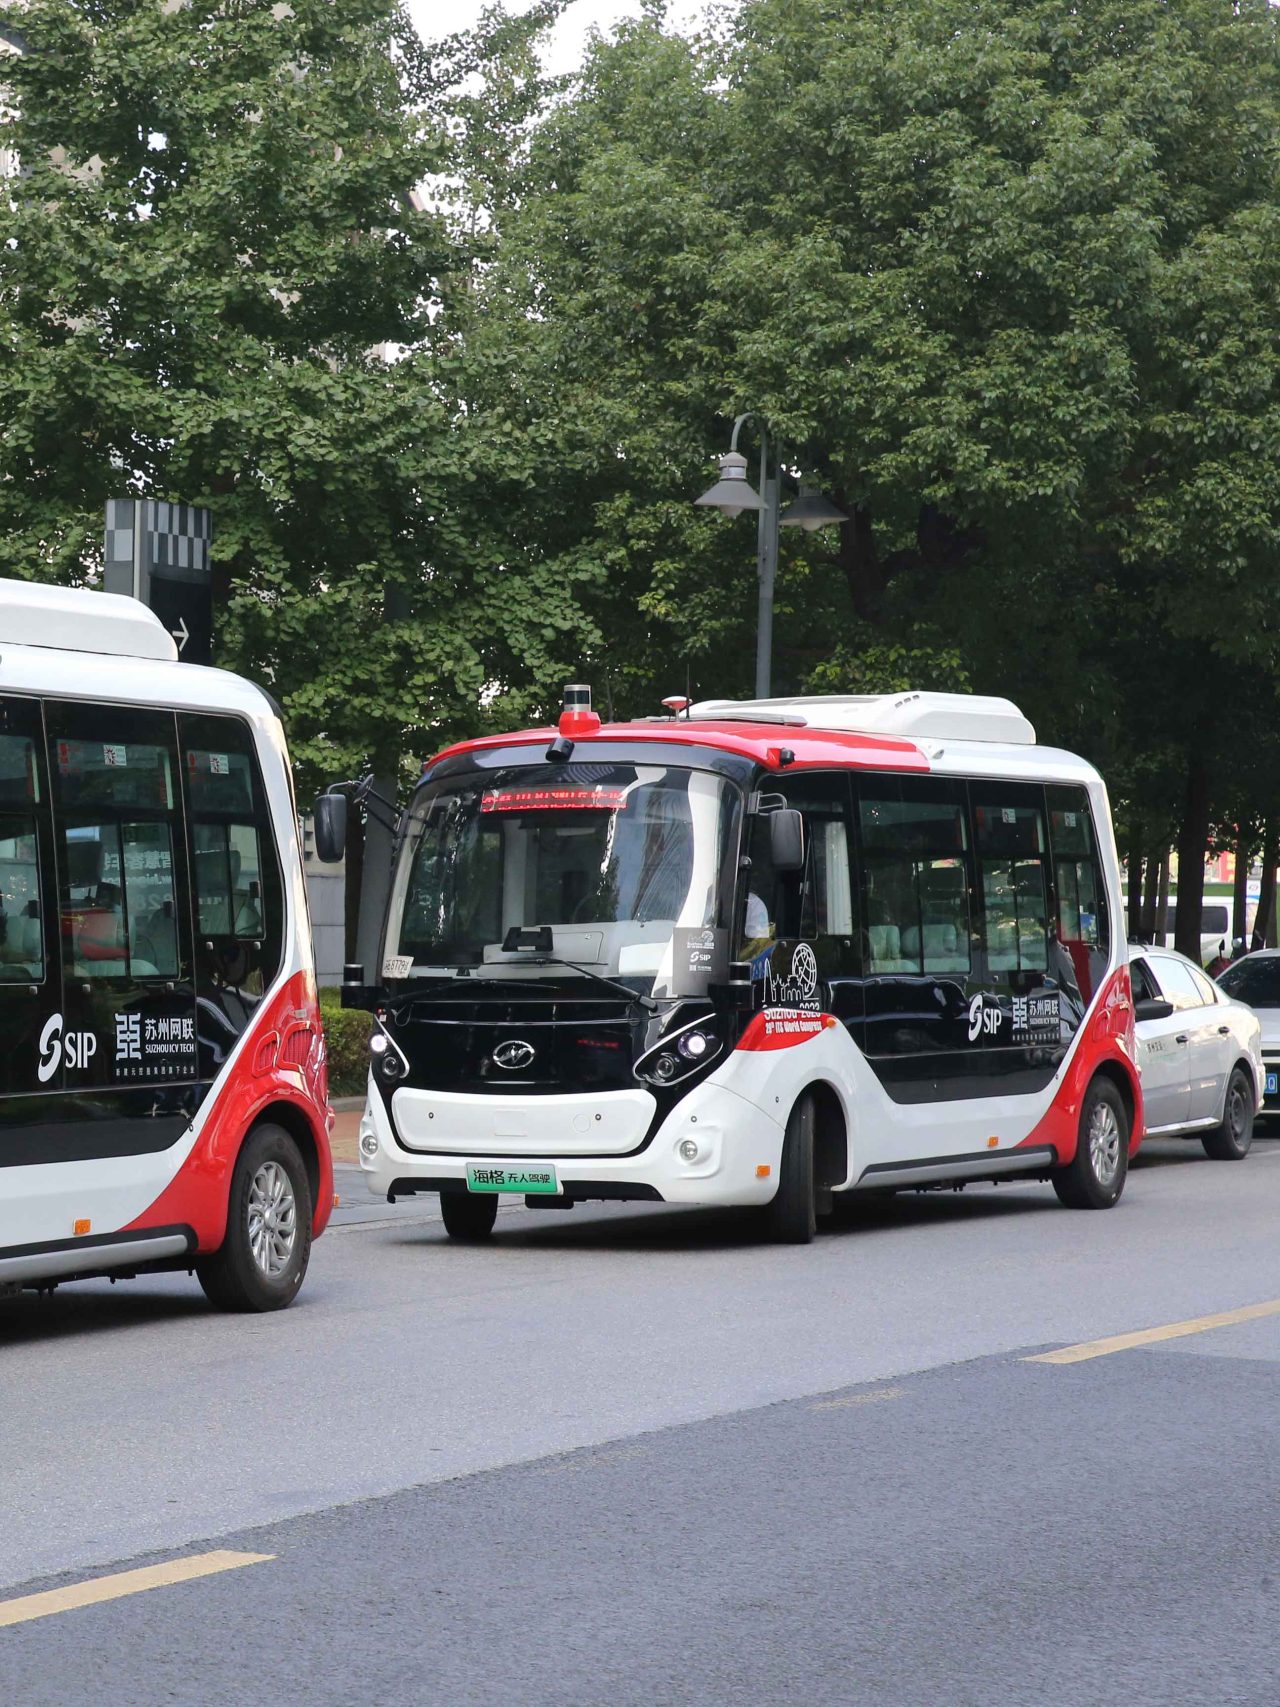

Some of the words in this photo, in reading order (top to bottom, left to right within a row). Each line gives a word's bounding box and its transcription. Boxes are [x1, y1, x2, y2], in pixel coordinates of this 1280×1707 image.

[762, 1004, 797, 1020] Suzhou
[799, 1002, 821, 1018] 2023
[145, 1018, 195, 1041] 苏州网联
[983, 1008, 1002, 1035] SIP
[64, 1032, 97, 1068] SIP
[145, 1044, 169, 1053] SUZHOU
[169, 1044, 179, 1053] ICV
[180, 1043, 195, 1053] TECH
[473, 1169, 505, 1184] 海格
[508, 1173, 550, 1184] 无人驾驶
